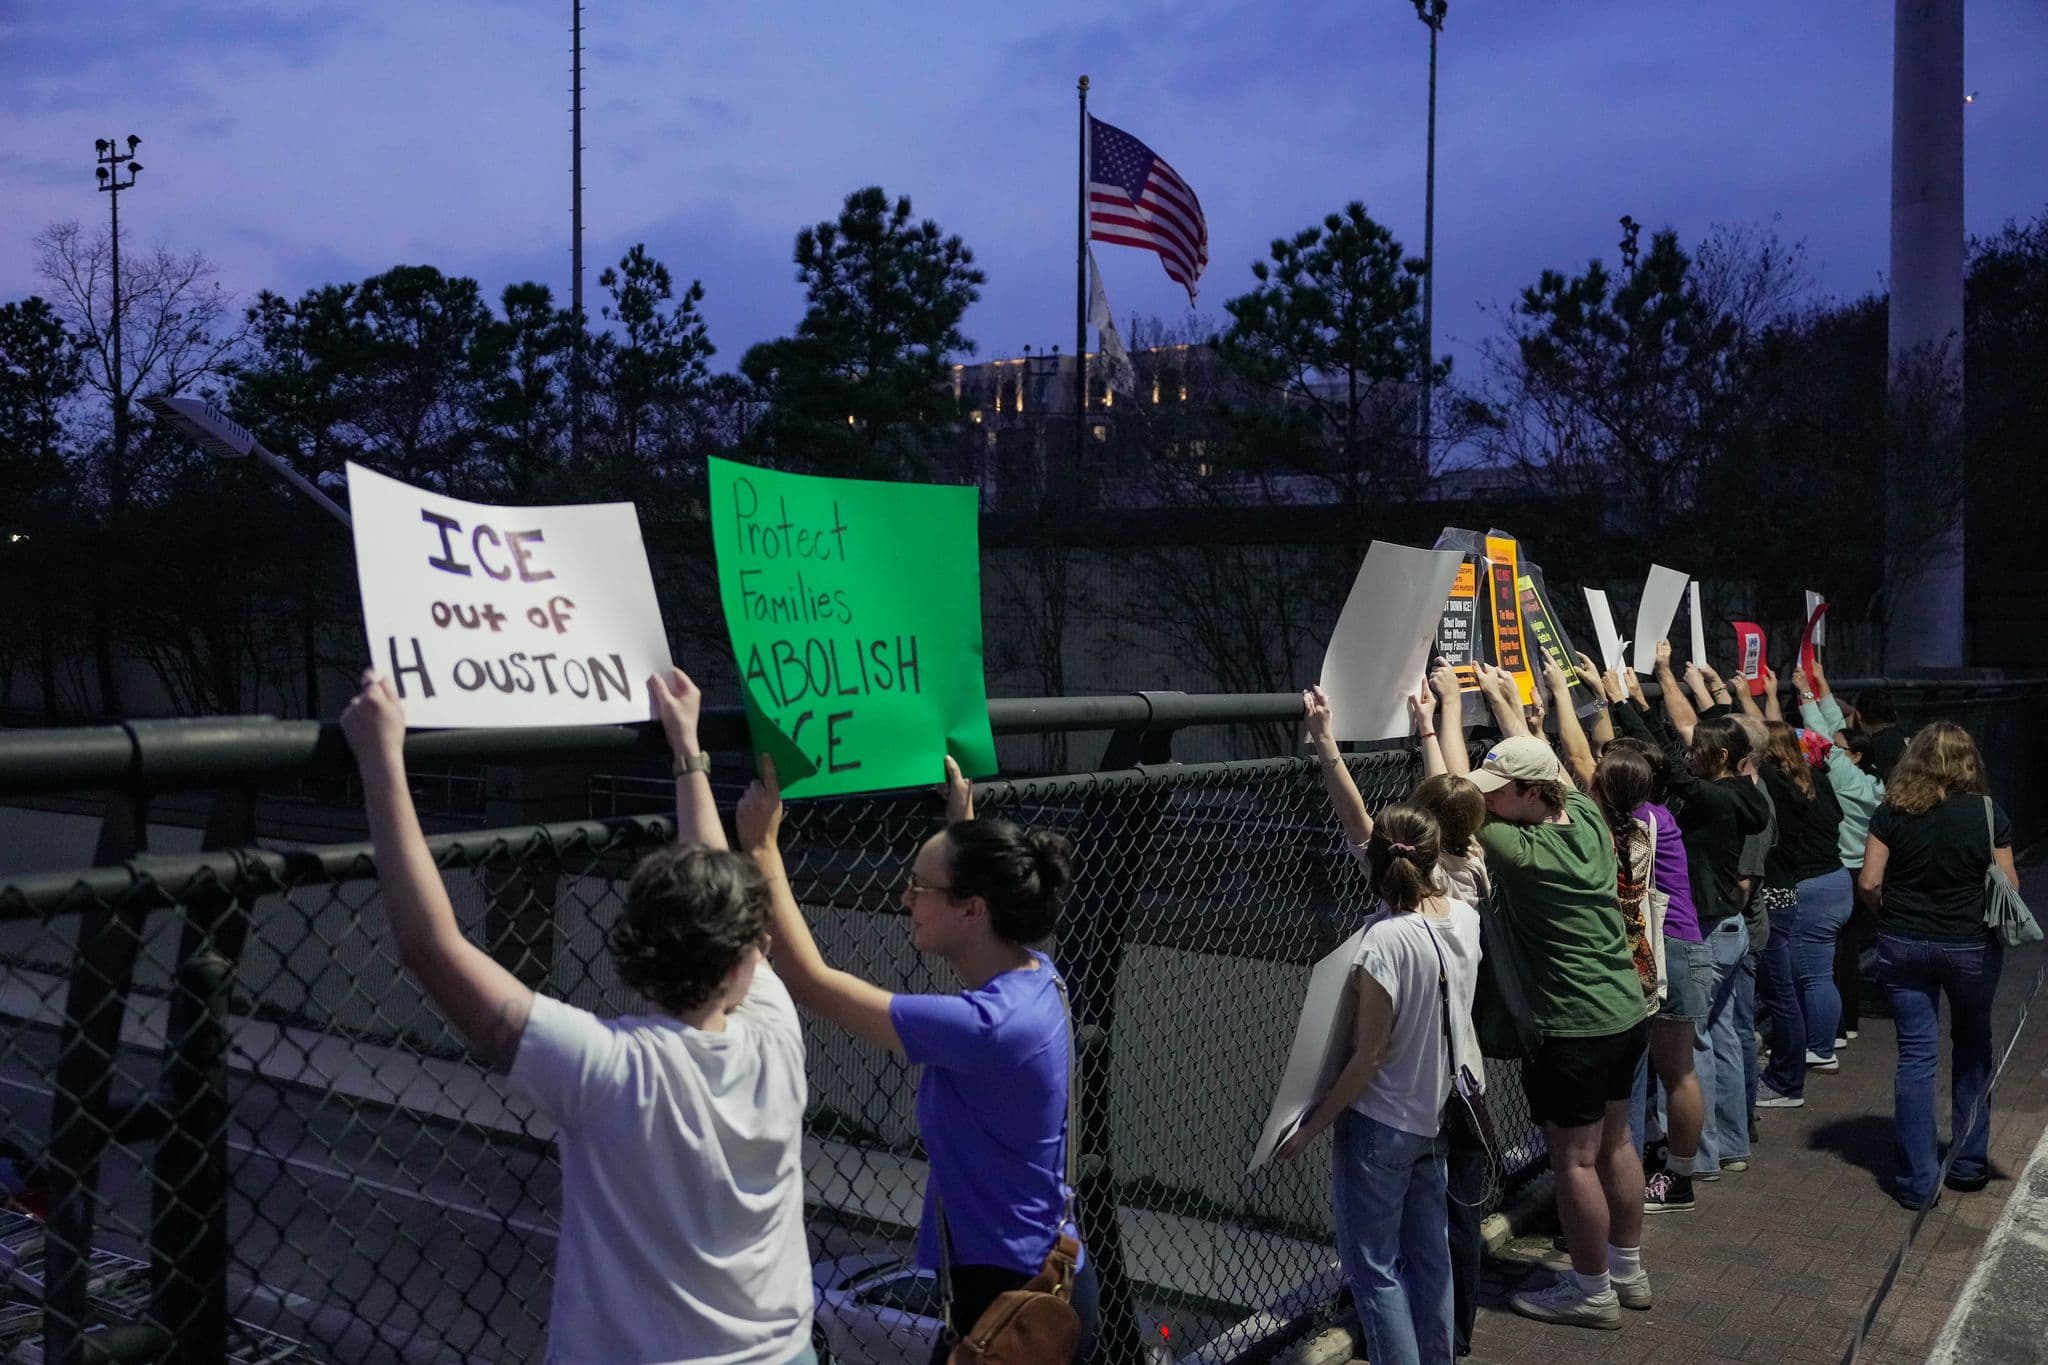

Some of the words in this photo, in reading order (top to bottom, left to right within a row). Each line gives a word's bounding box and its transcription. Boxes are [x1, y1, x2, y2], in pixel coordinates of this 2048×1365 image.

[421, 508, 556, 582] ICE
[733, 477, 848, 561] Protect
[431, 601, 507, 632] out
[527, 595, 575, 634] of
[740, 569, 852, 624] Families
[389, 636, 631, 701] HOUSTON
[747, 636, 920, 708] ABOLISH
[774, 710, 861, 774] CE
